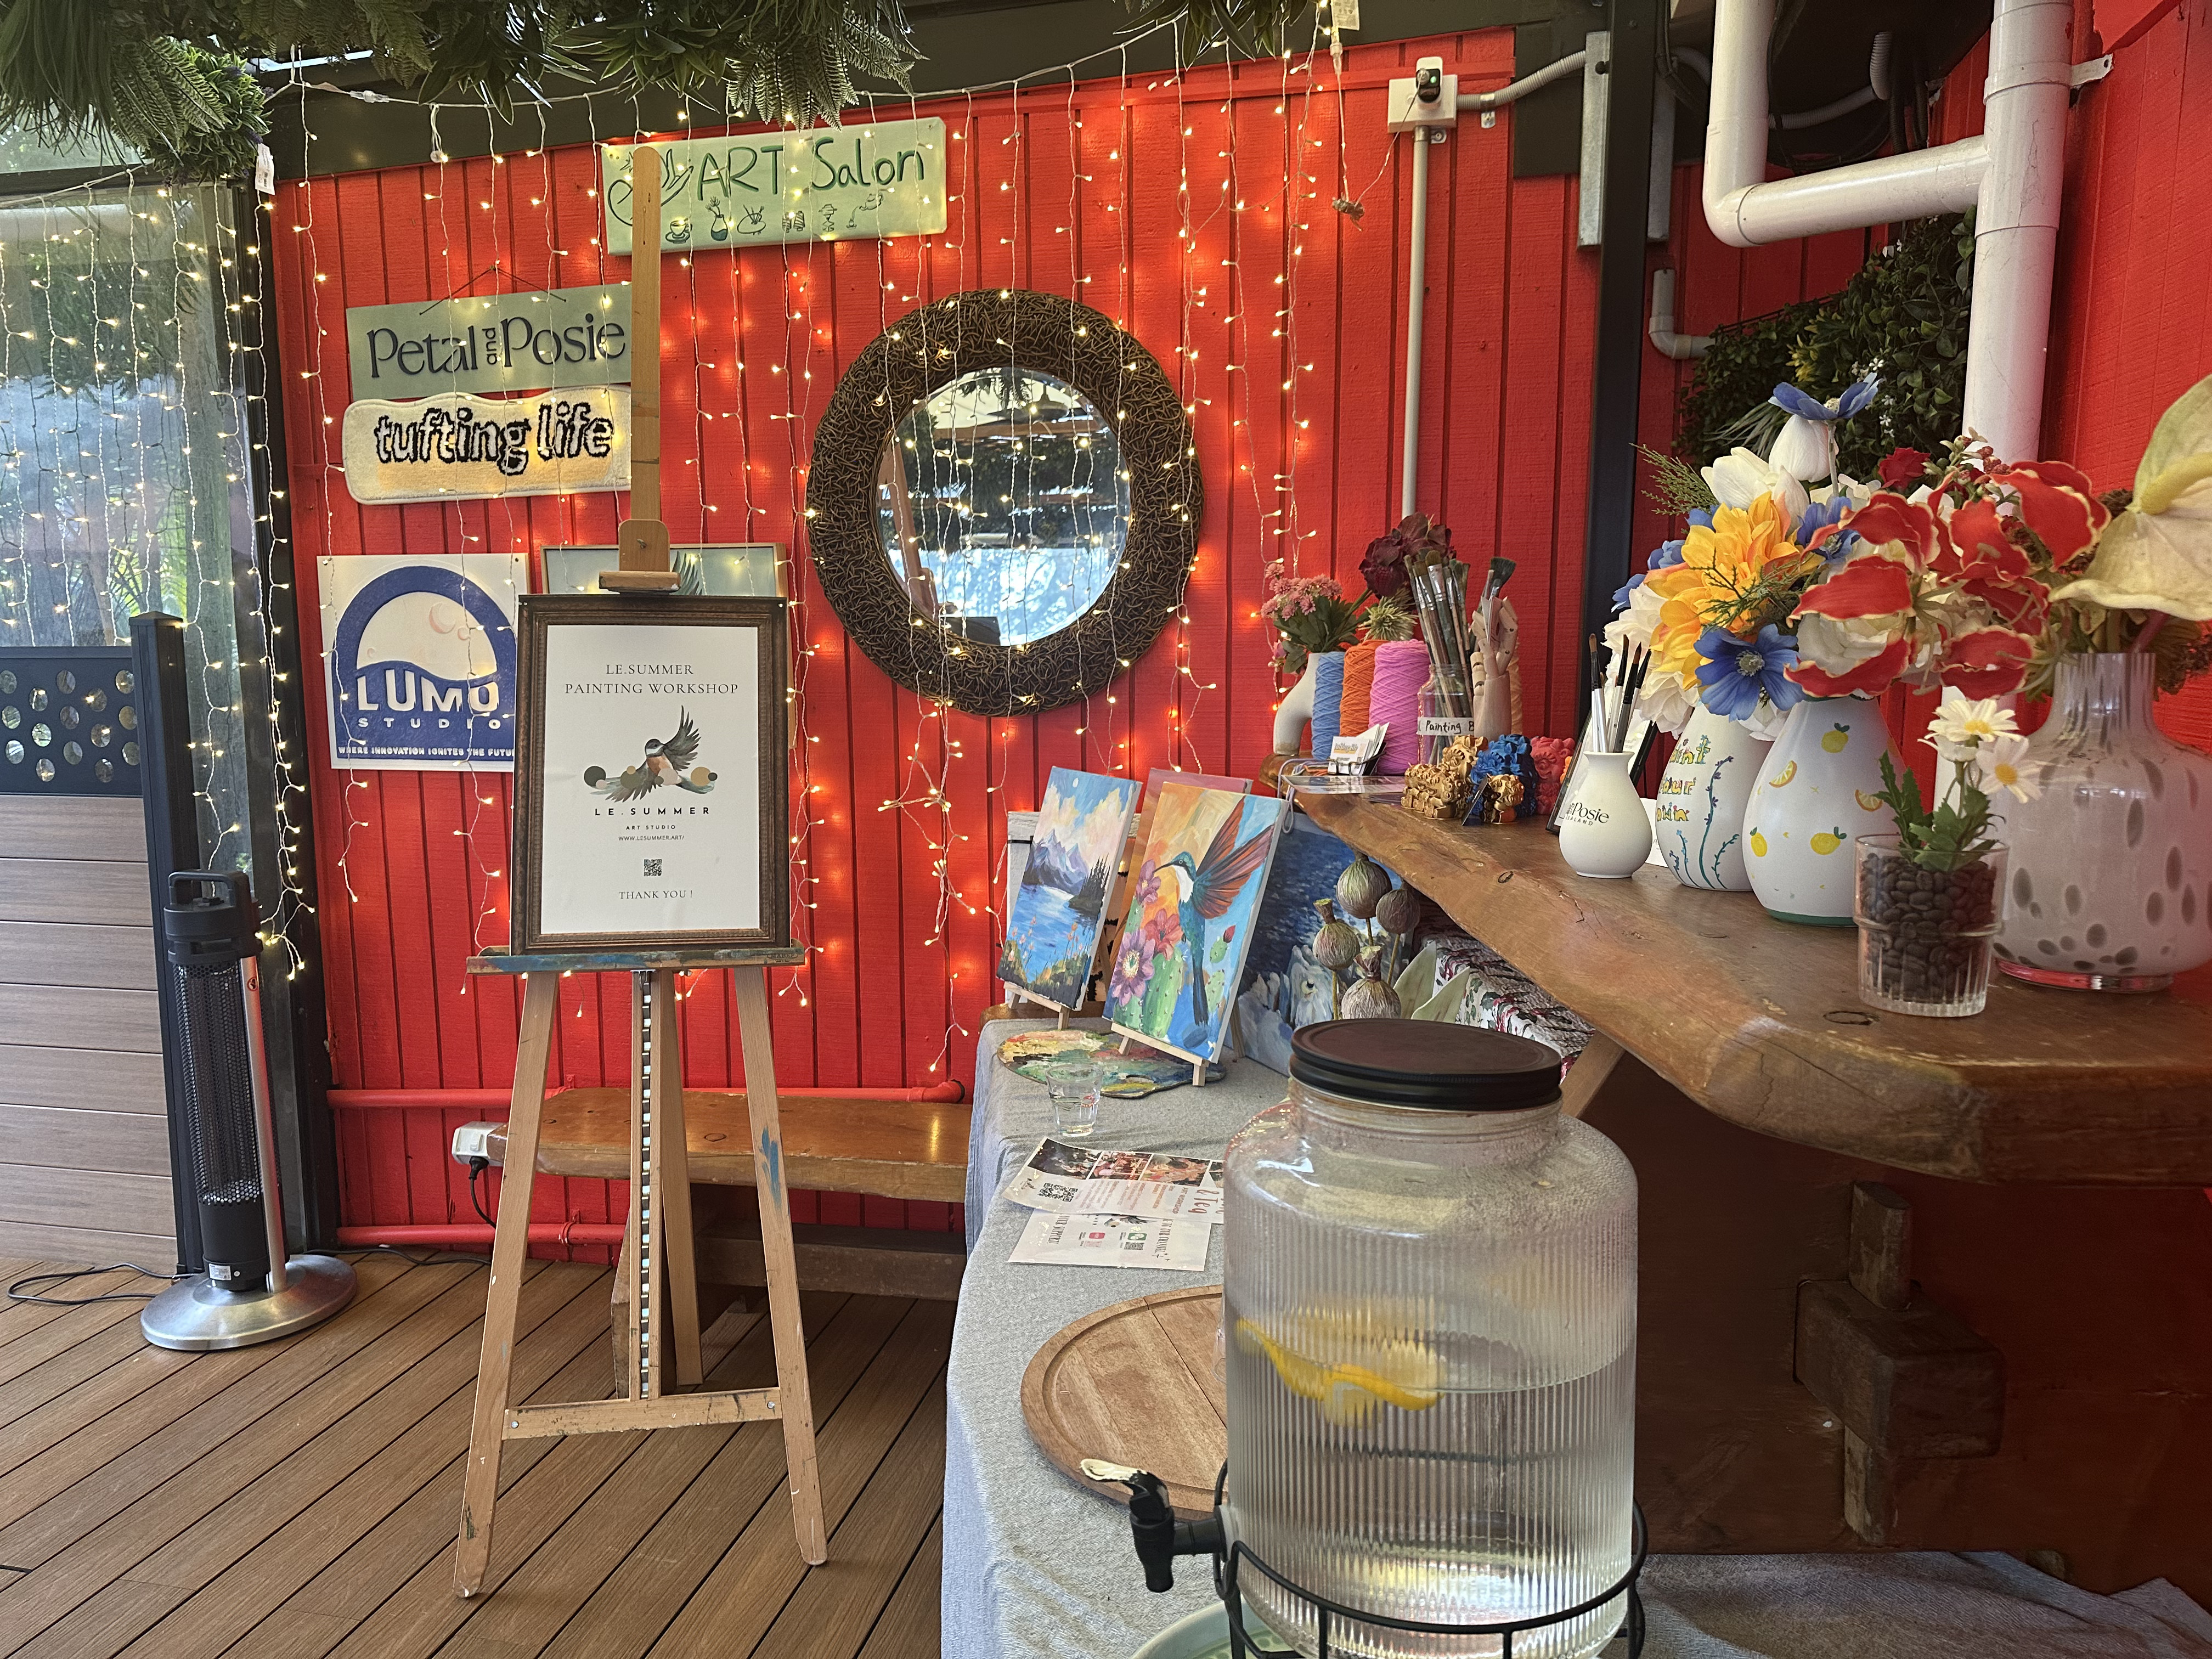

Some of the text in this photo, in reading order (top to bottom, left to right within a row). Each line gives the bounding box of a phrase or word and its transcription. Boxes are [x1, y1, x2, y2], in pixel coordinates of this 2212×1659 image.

[697, 137, 924, 201] ART Salon
[366, 313, 625, 379] Petal and Posie
[374, 400, 614, 475] tufting life
[606, 664, 694, 675] LE.SUMMER
[357, 669, 500, 712] LUMO
[565, 683, 738, 695] PAINTING WORKSHOP
[358, 718, 501, 730] STUDIO
[1426, 720, 1462, 735] Painting
[338, 746, 369, 755] WHERE
[371, 747, 425, 755] INNOVATION
[428, 747, 464, 756] IGNITES
[466, 747, 485, 757] THE
[1669, 735, 1711, 765] aint
[1660, 776, 1697, 795] our
[1571, 802, 1610, 823] Posie
[1656, 802, 1690, 822] own
[618, 890, 659, 900] THANK
[662, 890, 686, 899] YOU
[1188, 1198, 1218, 1214] Tea
[1055, 1215, 1070, 1225] YOUR
[1155, 1237, 1170, 1254] CHANNEL
